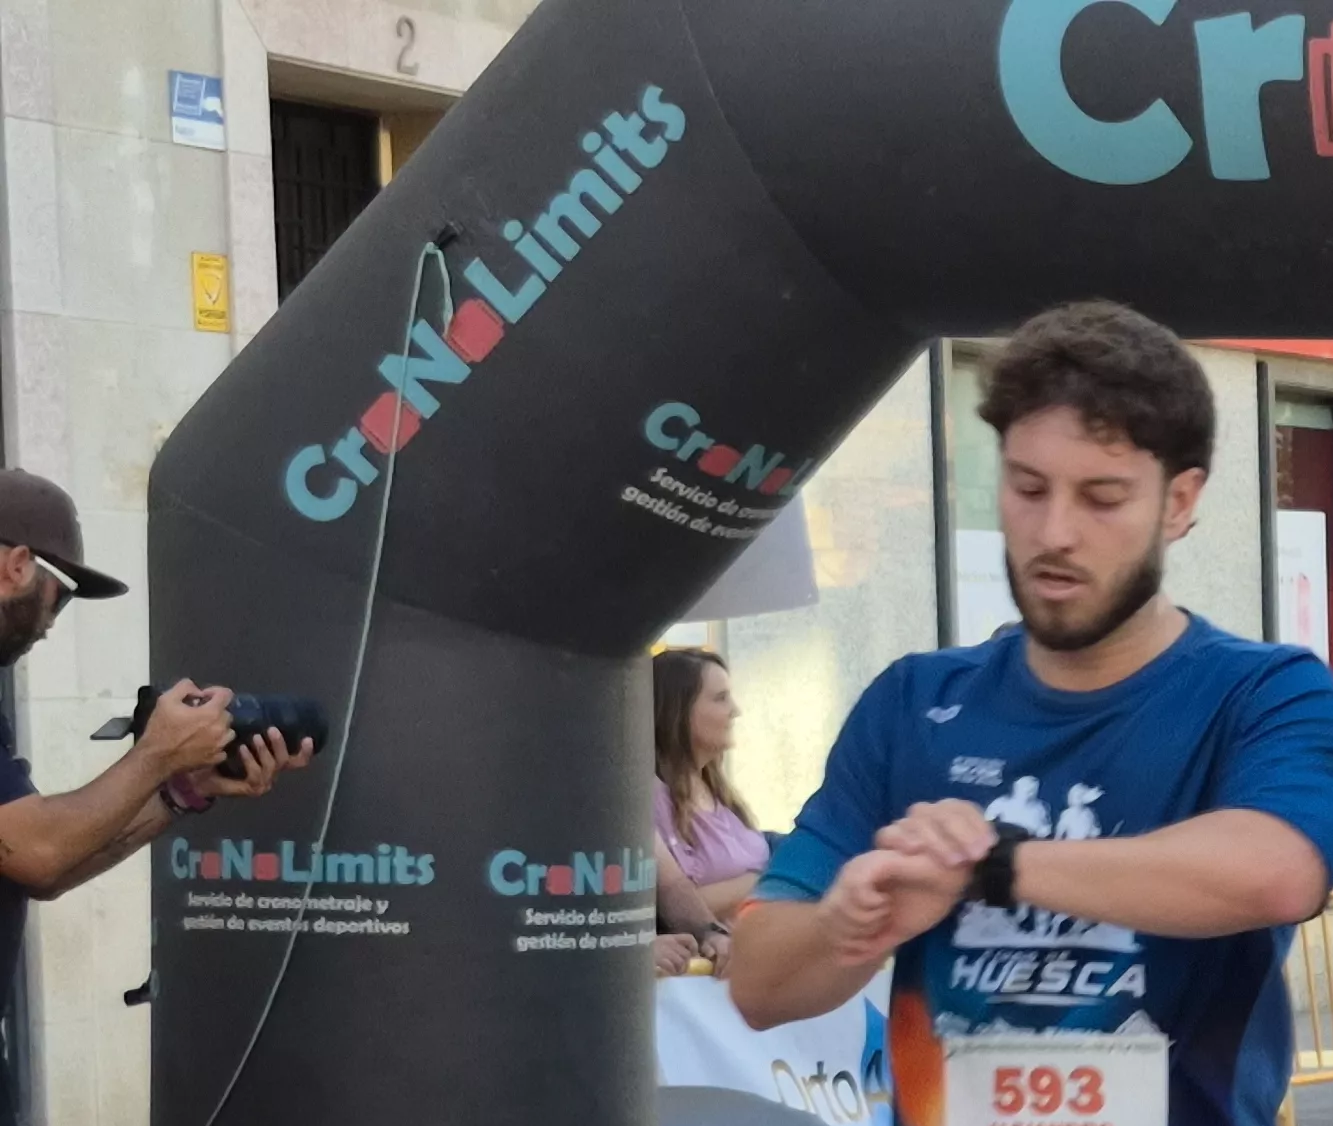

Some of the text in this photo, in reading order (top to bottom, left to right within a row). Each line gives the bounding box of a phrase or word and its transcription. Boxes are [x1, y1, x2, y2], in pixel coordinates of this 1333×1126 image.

[397, 17, 420, 76] 2
[313, 917, 411, 935] deportivos
[375, 899, 389, 915] y
[952, 955, 1147, 998] HUESCA
[993, 1066, 1105, 1117] 593
